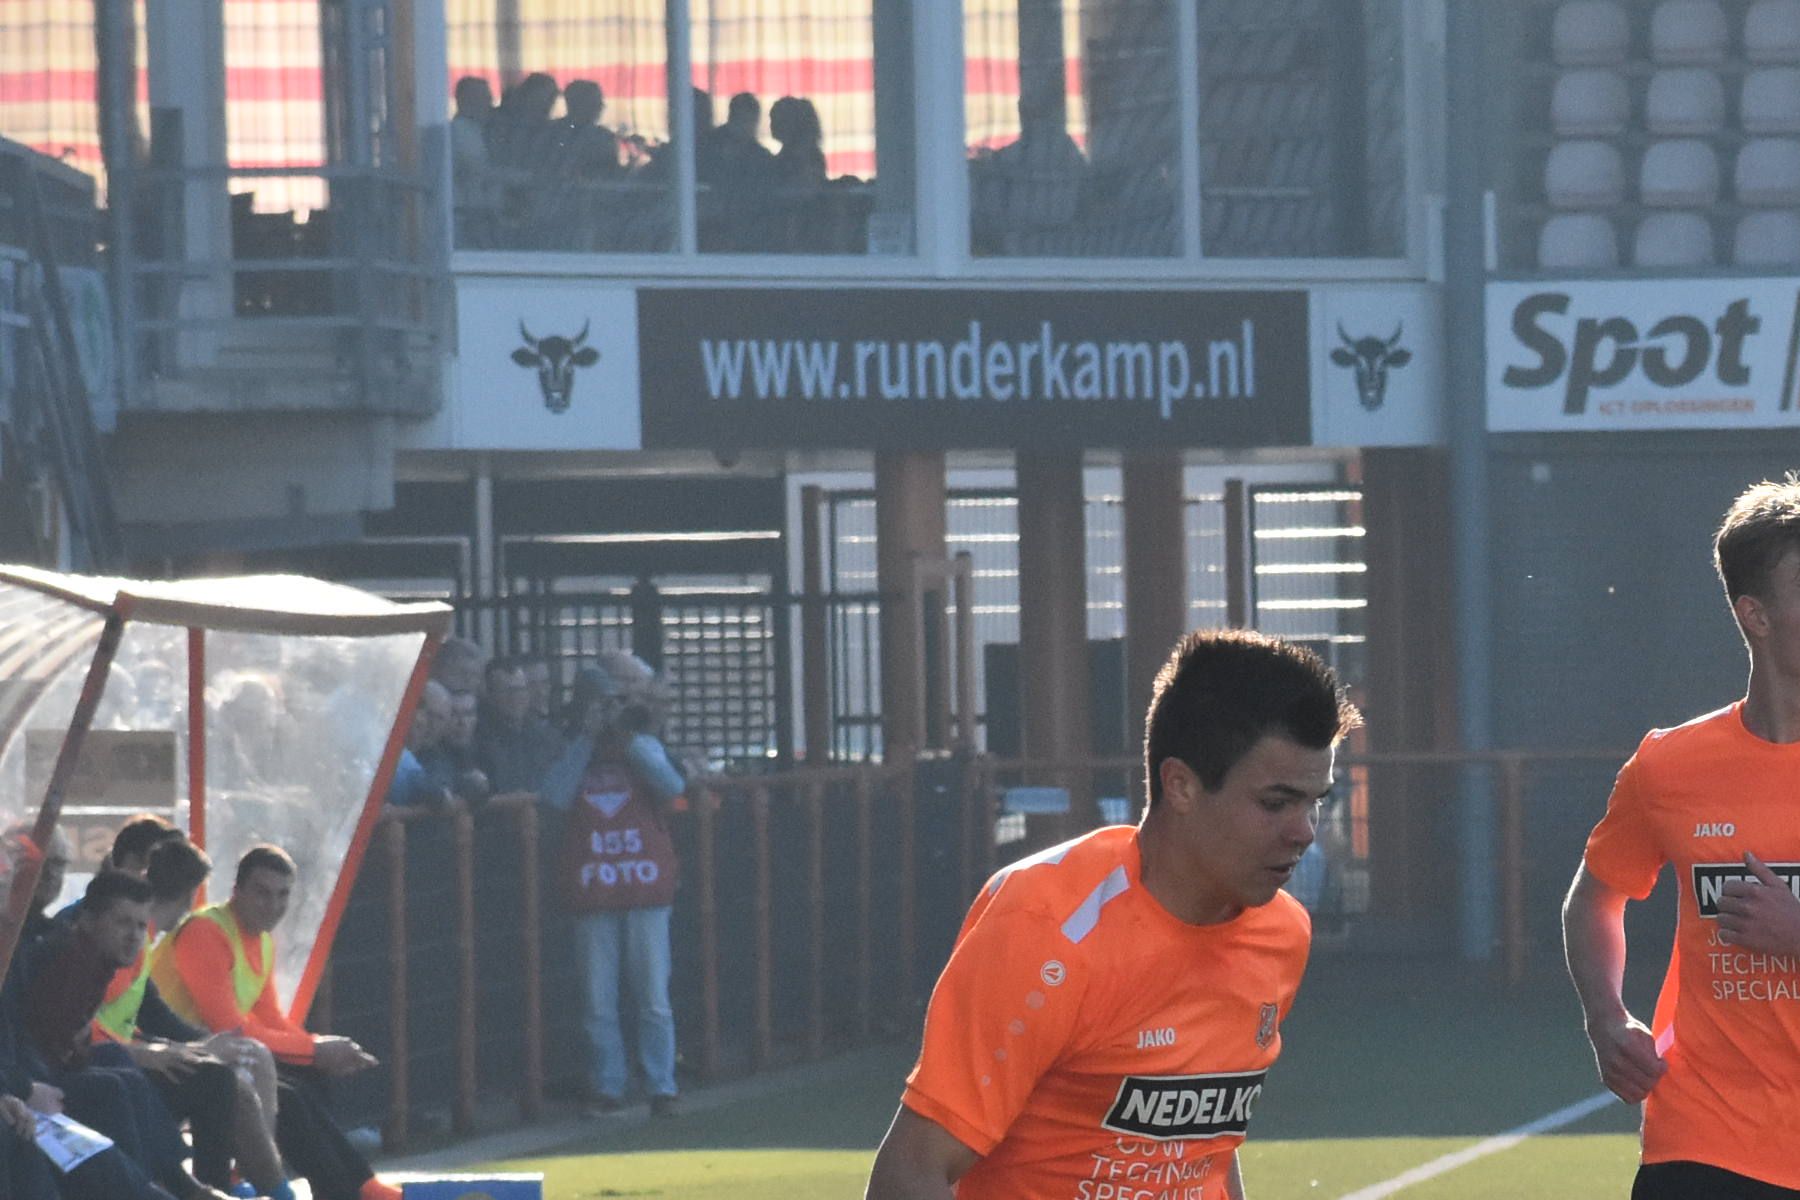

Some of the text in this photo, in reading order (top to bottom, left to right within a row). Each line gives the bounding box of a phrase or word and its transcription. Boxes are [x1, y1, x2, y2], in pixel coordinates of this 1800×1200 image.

[1502, 292, 1761, 414] Spot
[702, 319, 1255, 419] www.runderkamp.nl
[1693, 822, 1736, 837] JAKO
[580, 859, 660, 888] FOTO
[1136, 1026, 1177, 1050] JAKO
